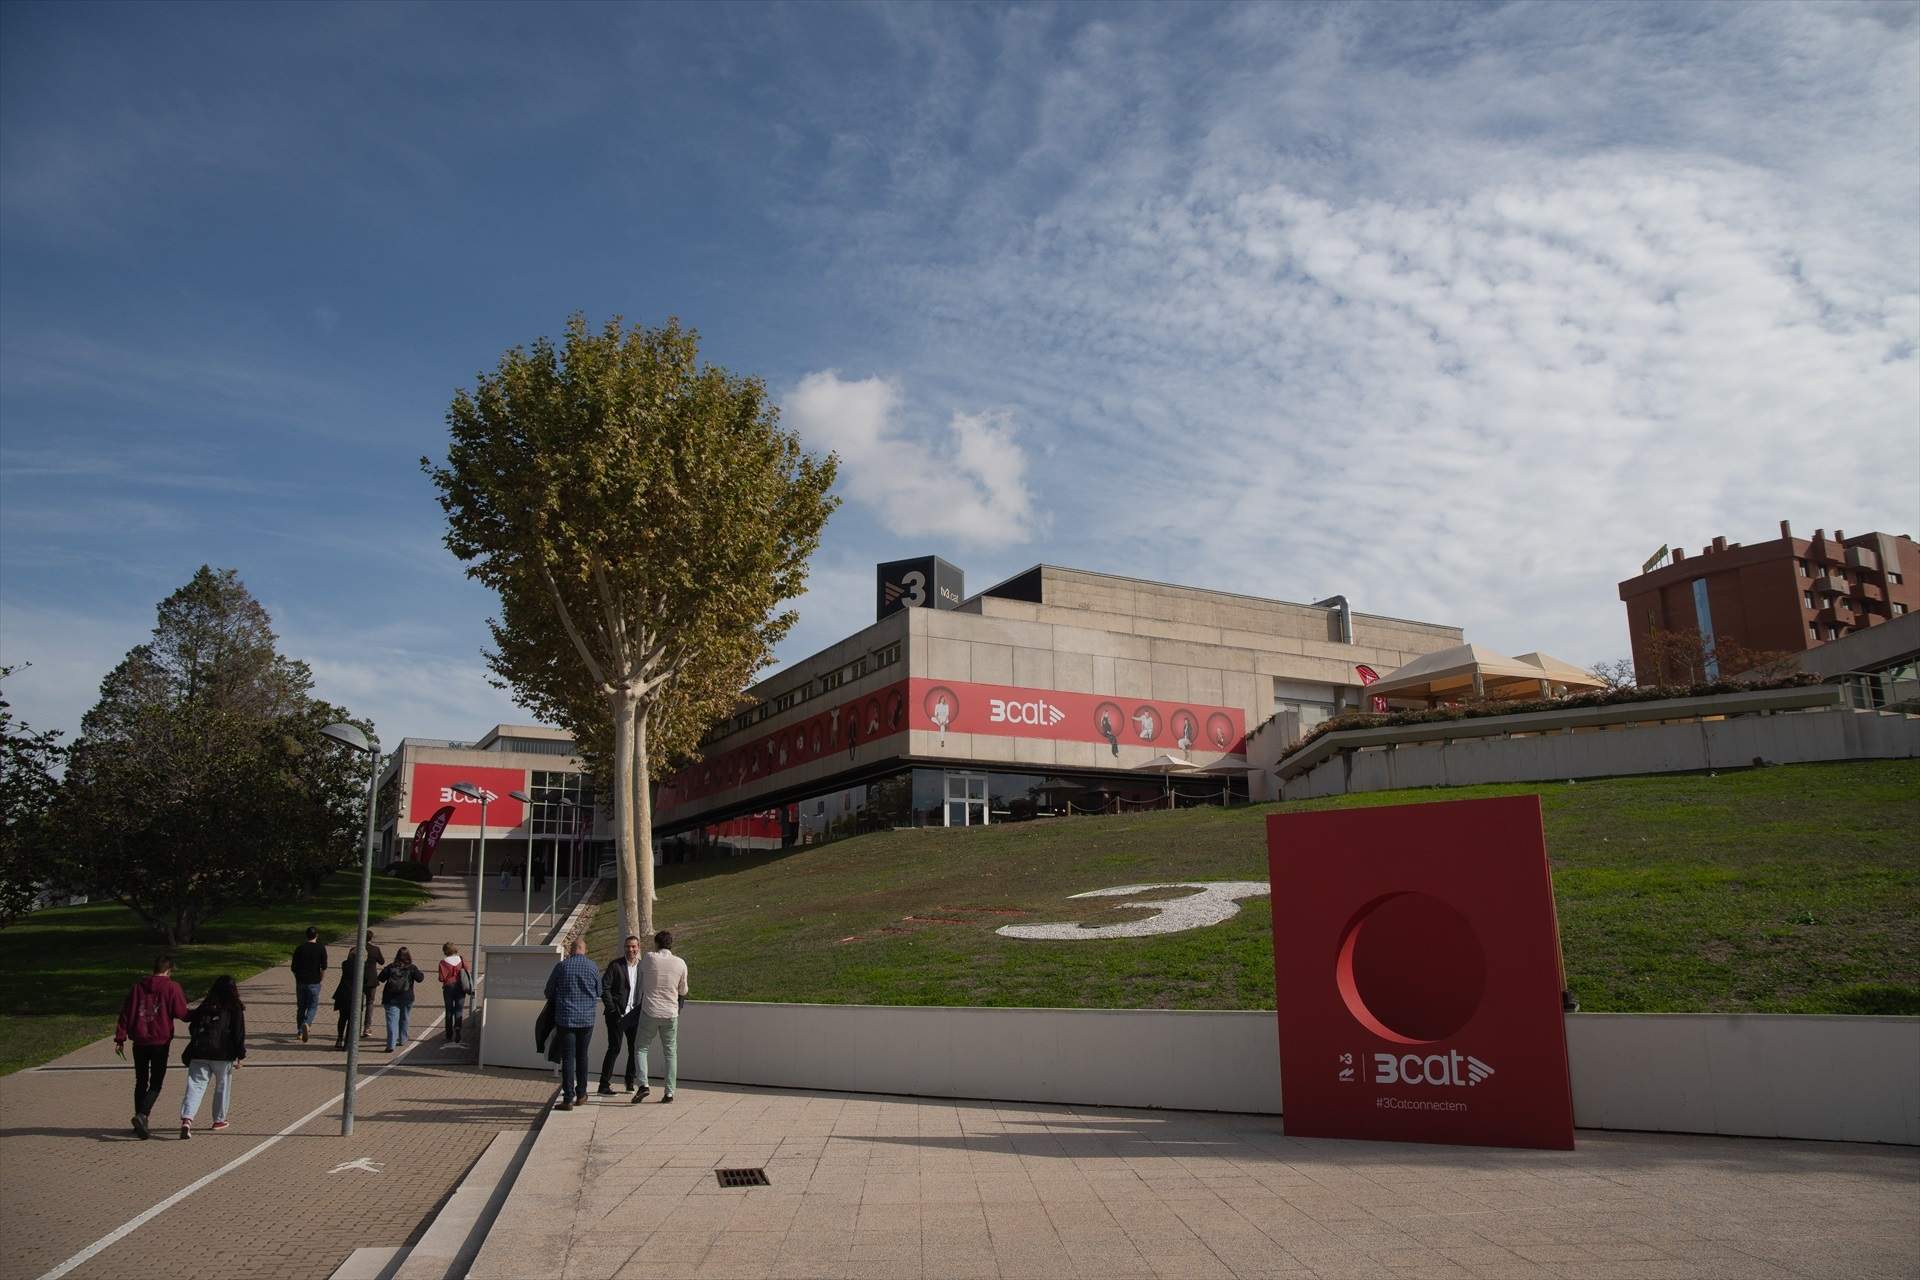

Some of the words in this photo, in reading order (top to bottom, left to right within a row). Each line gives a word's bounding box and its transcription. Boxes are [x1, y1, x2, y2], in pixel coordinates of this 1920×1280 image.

[901, 570, 926, 608] 3
[990, 699, 1048, 726] 3cat
[1374, 1049, 1467, 1087] 3cat
[1376, 1097, 1467, 1112] #3Catconnectem
